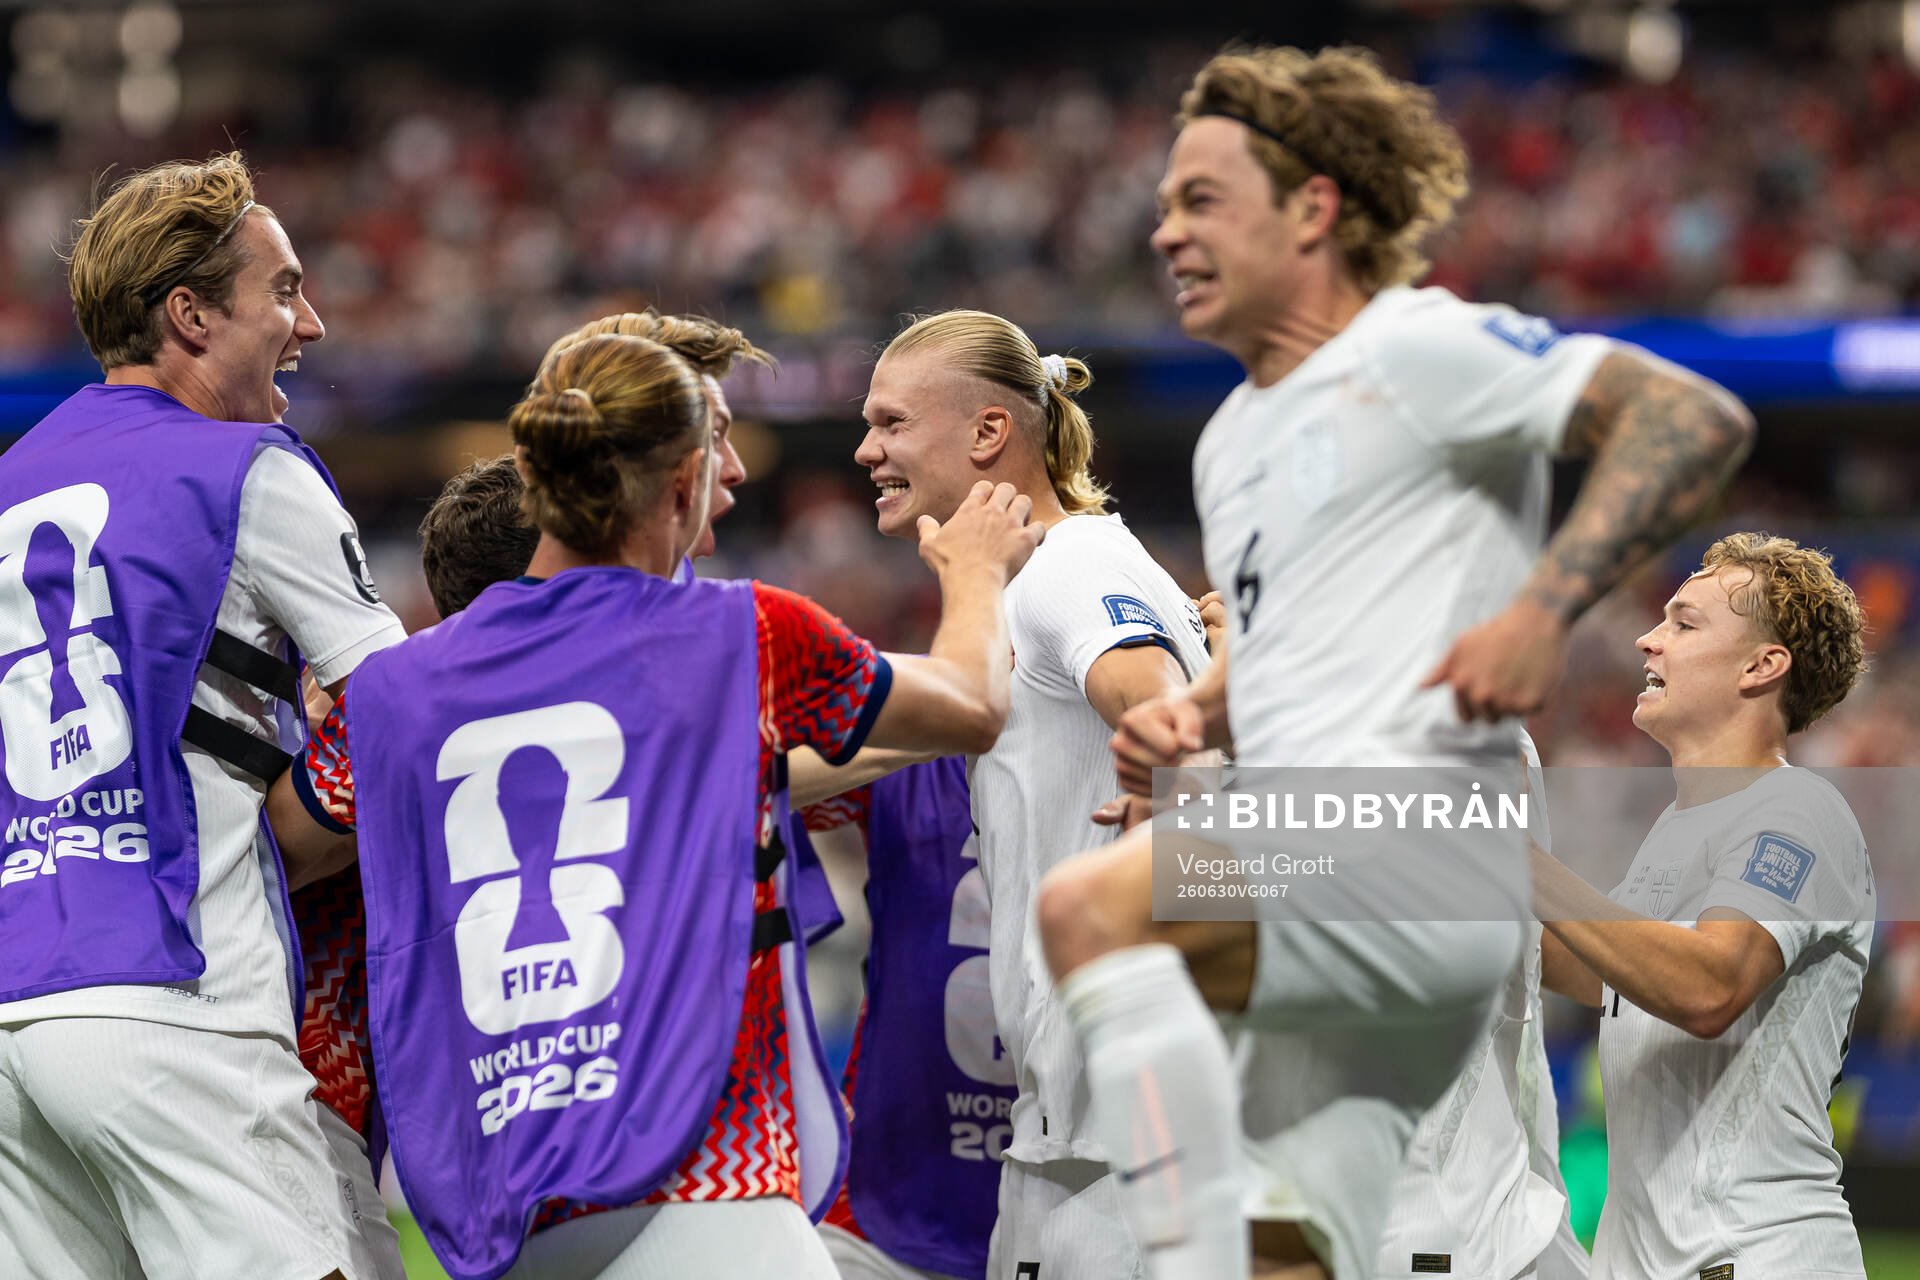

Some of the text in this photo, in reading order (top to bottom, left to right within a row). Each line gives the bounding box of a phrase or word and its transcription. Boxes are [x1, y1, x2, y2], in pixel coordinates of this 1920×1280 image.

[50, 724, 92, 771] FIFA
[82, 788, 145, 817] CUP
[1760, 852, 1799, 878] UNITES
[1764, 843, 1802, 868] FOOTBALL
[1769, 867, 1796, 890] World
[502, 958, 578, 1001] FIFA
[470, 1022, 621, 1085] WORLD CUP
[477, 1056, 619, 1137] 2026
[946, 1093, 1012, 1118] WOR
[950, 1121, 1014, 1162] 20
